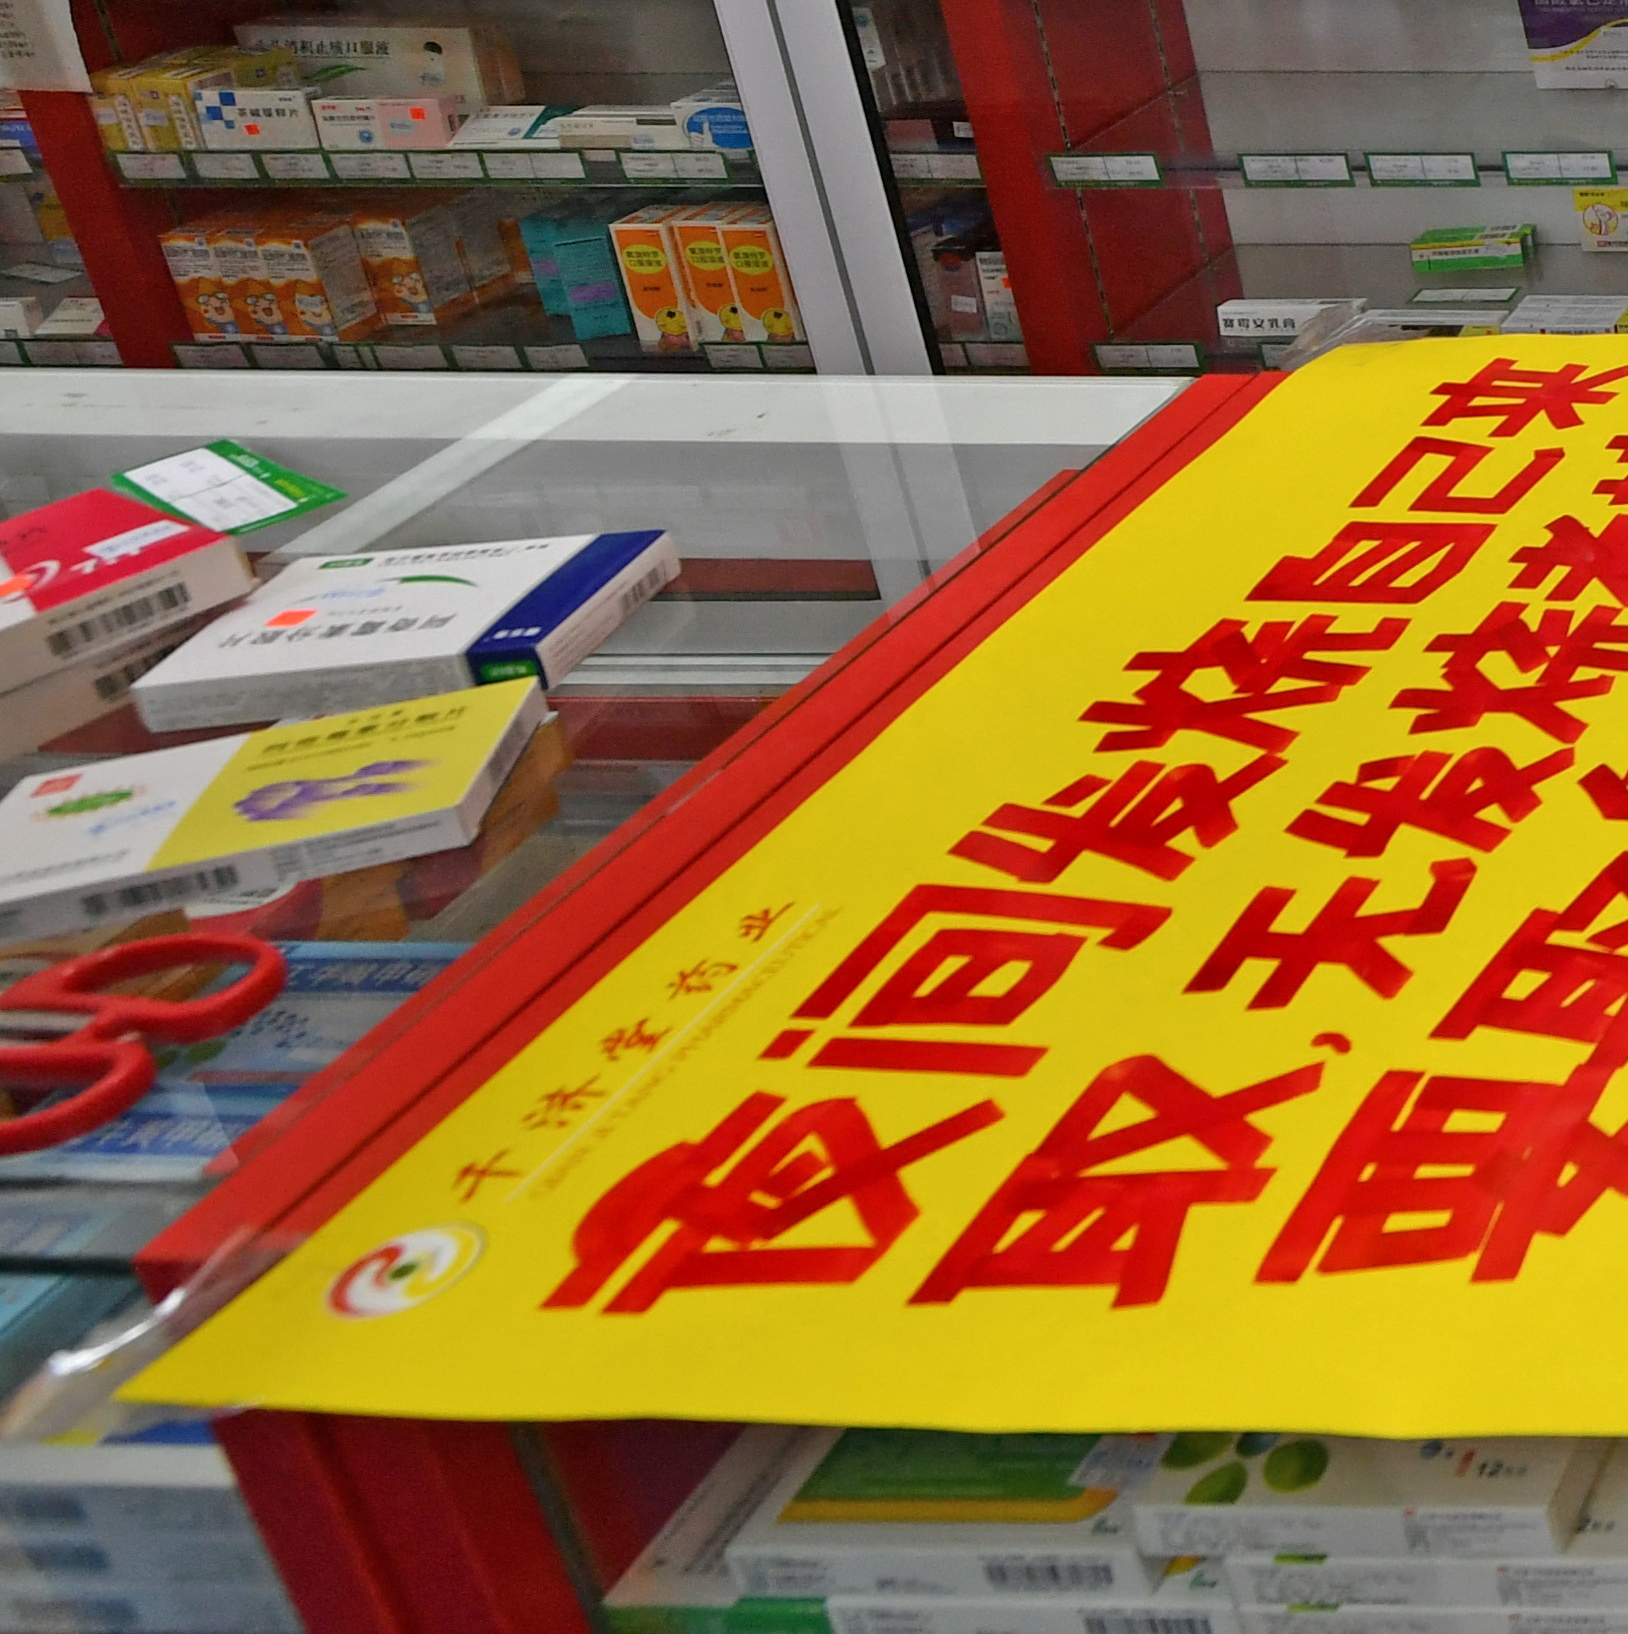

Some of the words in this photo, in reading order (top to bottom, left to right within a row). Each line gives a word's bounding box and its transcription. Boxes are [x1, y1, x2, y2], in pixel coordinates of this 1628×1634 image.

[219, 612, 459, 649] 阿奇霉素分散片
